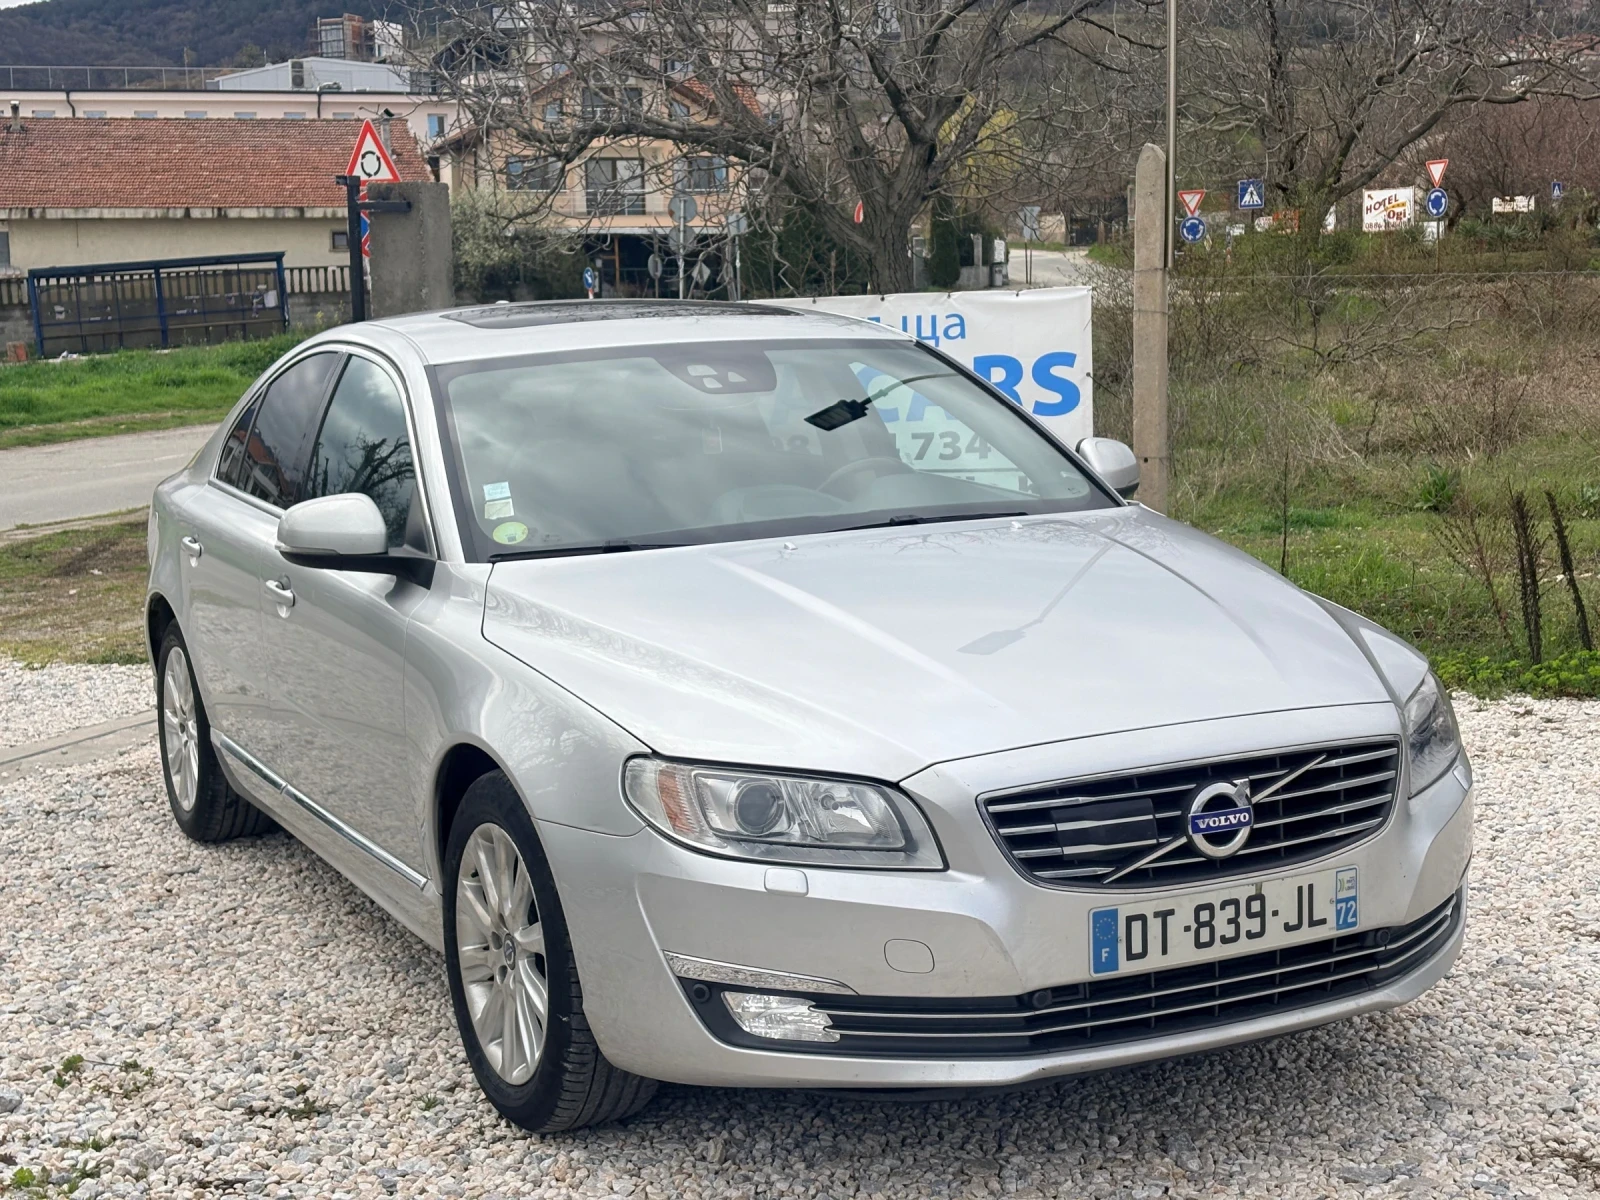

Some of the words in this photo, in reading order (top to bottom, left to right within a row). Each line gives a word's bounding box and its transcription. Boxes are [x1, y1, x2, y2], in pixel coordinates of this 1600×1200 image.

[1366, 193, 1398, 215] HOTEL
[867, 313, 966, 347] ща
[1195, 812, 1249, 829] VOLVO
[1125, 883, 1327, 961] DT-839-JL
[1337, 900, 1356, 925] 72
[1101, 948, 1110, 962] F
